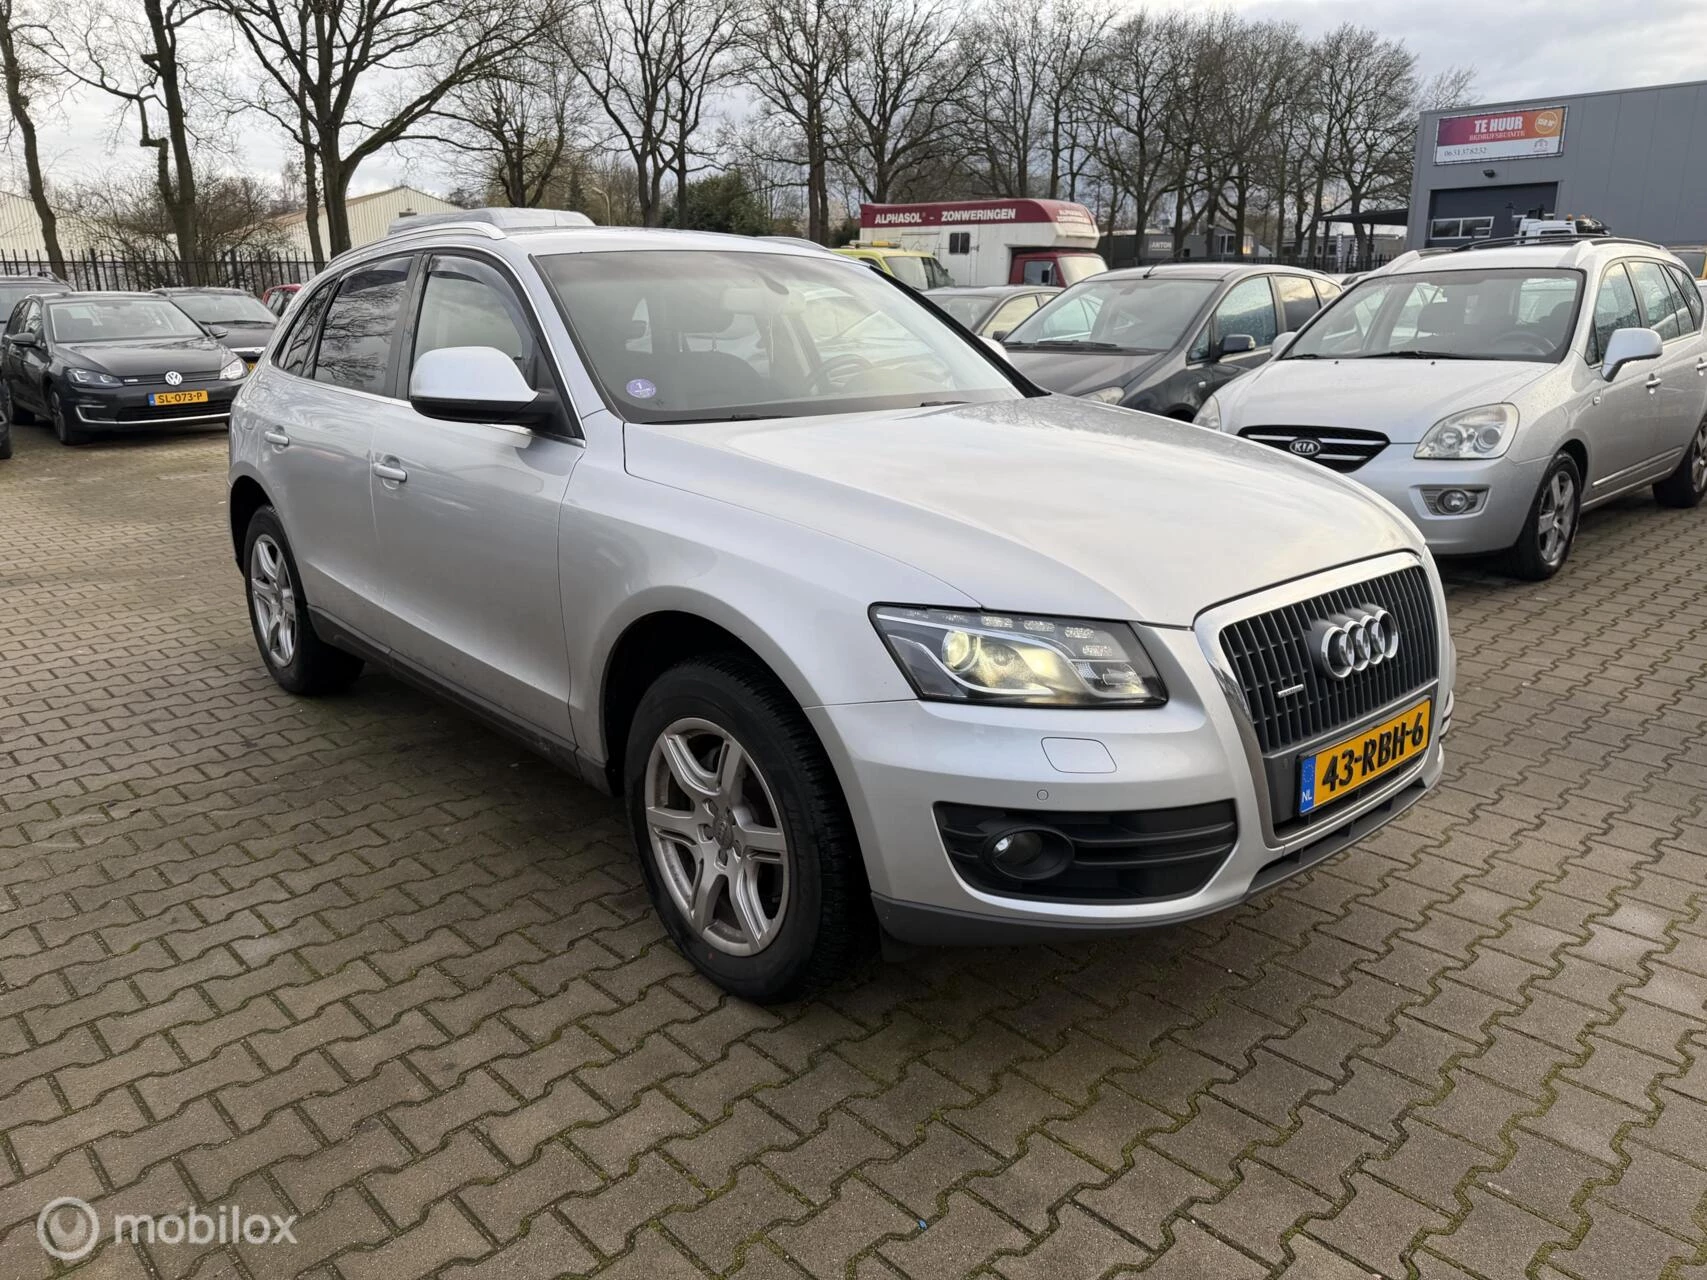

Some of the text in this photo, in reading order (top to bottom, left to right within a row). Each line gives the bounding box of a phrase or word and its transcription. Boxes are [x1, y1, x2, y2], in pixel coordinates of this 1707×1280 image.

[1474, 119, 1488, 134] TE
[1489, 116, 1524, 132] HUUR
[874, 212, 922, 224] ALPHASOL
[941, 208, 1016, 222] ZONWERINGEN
[158, 391, 203, 404] SL-073-P
[1294, 442, 1314, 452] KIA
[1321, 712, 1424, 792] 43-RBH-6
[1302, 790, 1313, 803] NL
